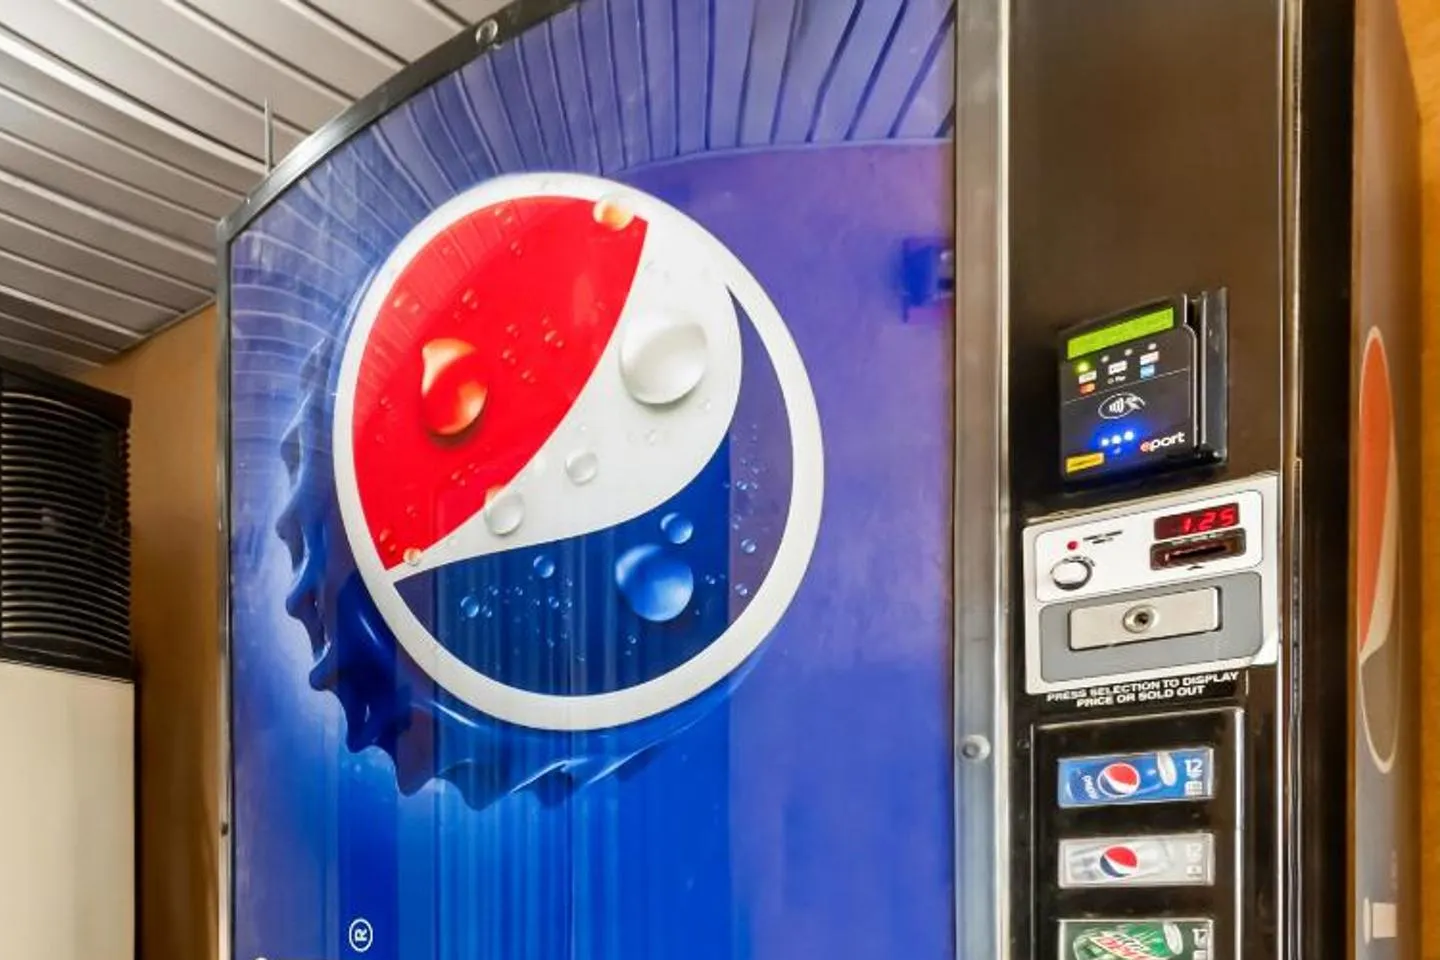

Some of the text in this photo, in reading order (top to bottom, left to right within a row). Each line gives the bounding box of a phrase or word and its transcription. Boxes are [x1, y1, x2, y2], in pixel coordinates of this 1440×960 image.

[1140, 431, 1185, 453] eport
[1047, 671, 1239, 702] PRESS SELECTION TO DISPLAY
[1076, 685, 1206, 708] PRICE OR SOLD OUT
[1184, 758, 1203, 773] 12
